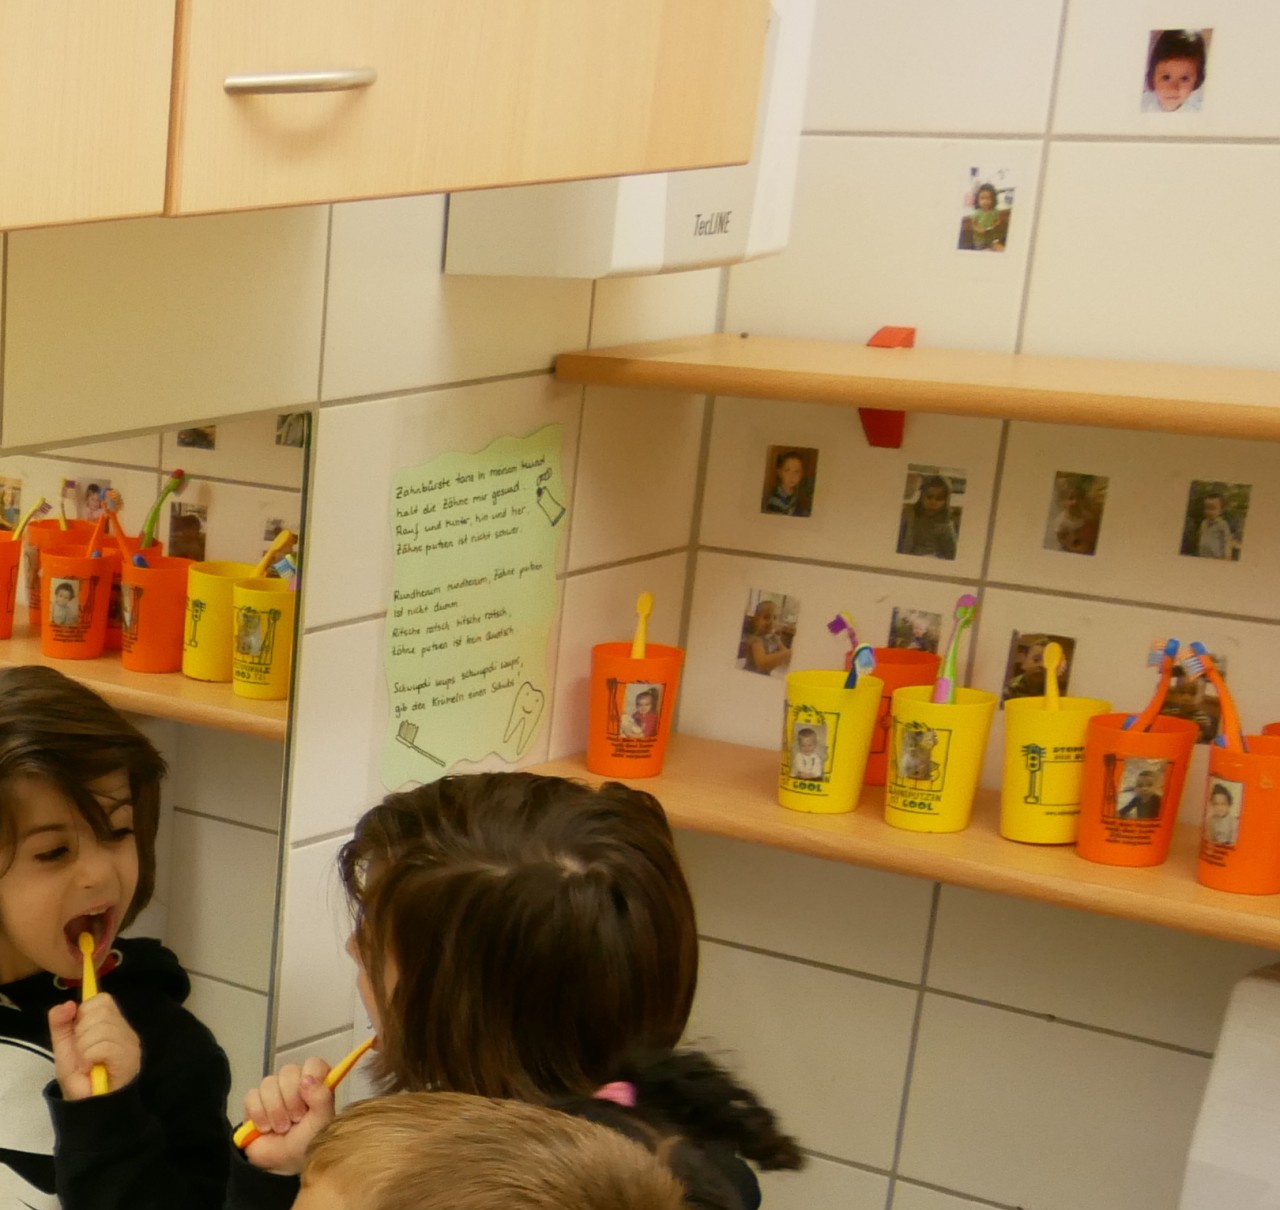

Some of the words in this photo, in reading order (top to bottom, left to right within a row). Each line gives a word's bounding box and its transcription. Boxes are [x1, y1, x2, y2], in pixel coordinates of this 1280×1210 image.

[694, 210, 732, 236] TecLINE
[478, 470, 486, 481] in
[422, 503, 437, 514] die
[395, 523, 419, 541] Rauf
[424, 521, 442, 532] und
[475, 513, 489, 523] hin
[491, 509, 507, 520] und
[458, 534, 468, 546] ist
[393, 606, 404, 618] ist
[453, 635, 462, 647] ist
[394, 703, 408, 718] gib
[902, 799, 934, 811] COOL
